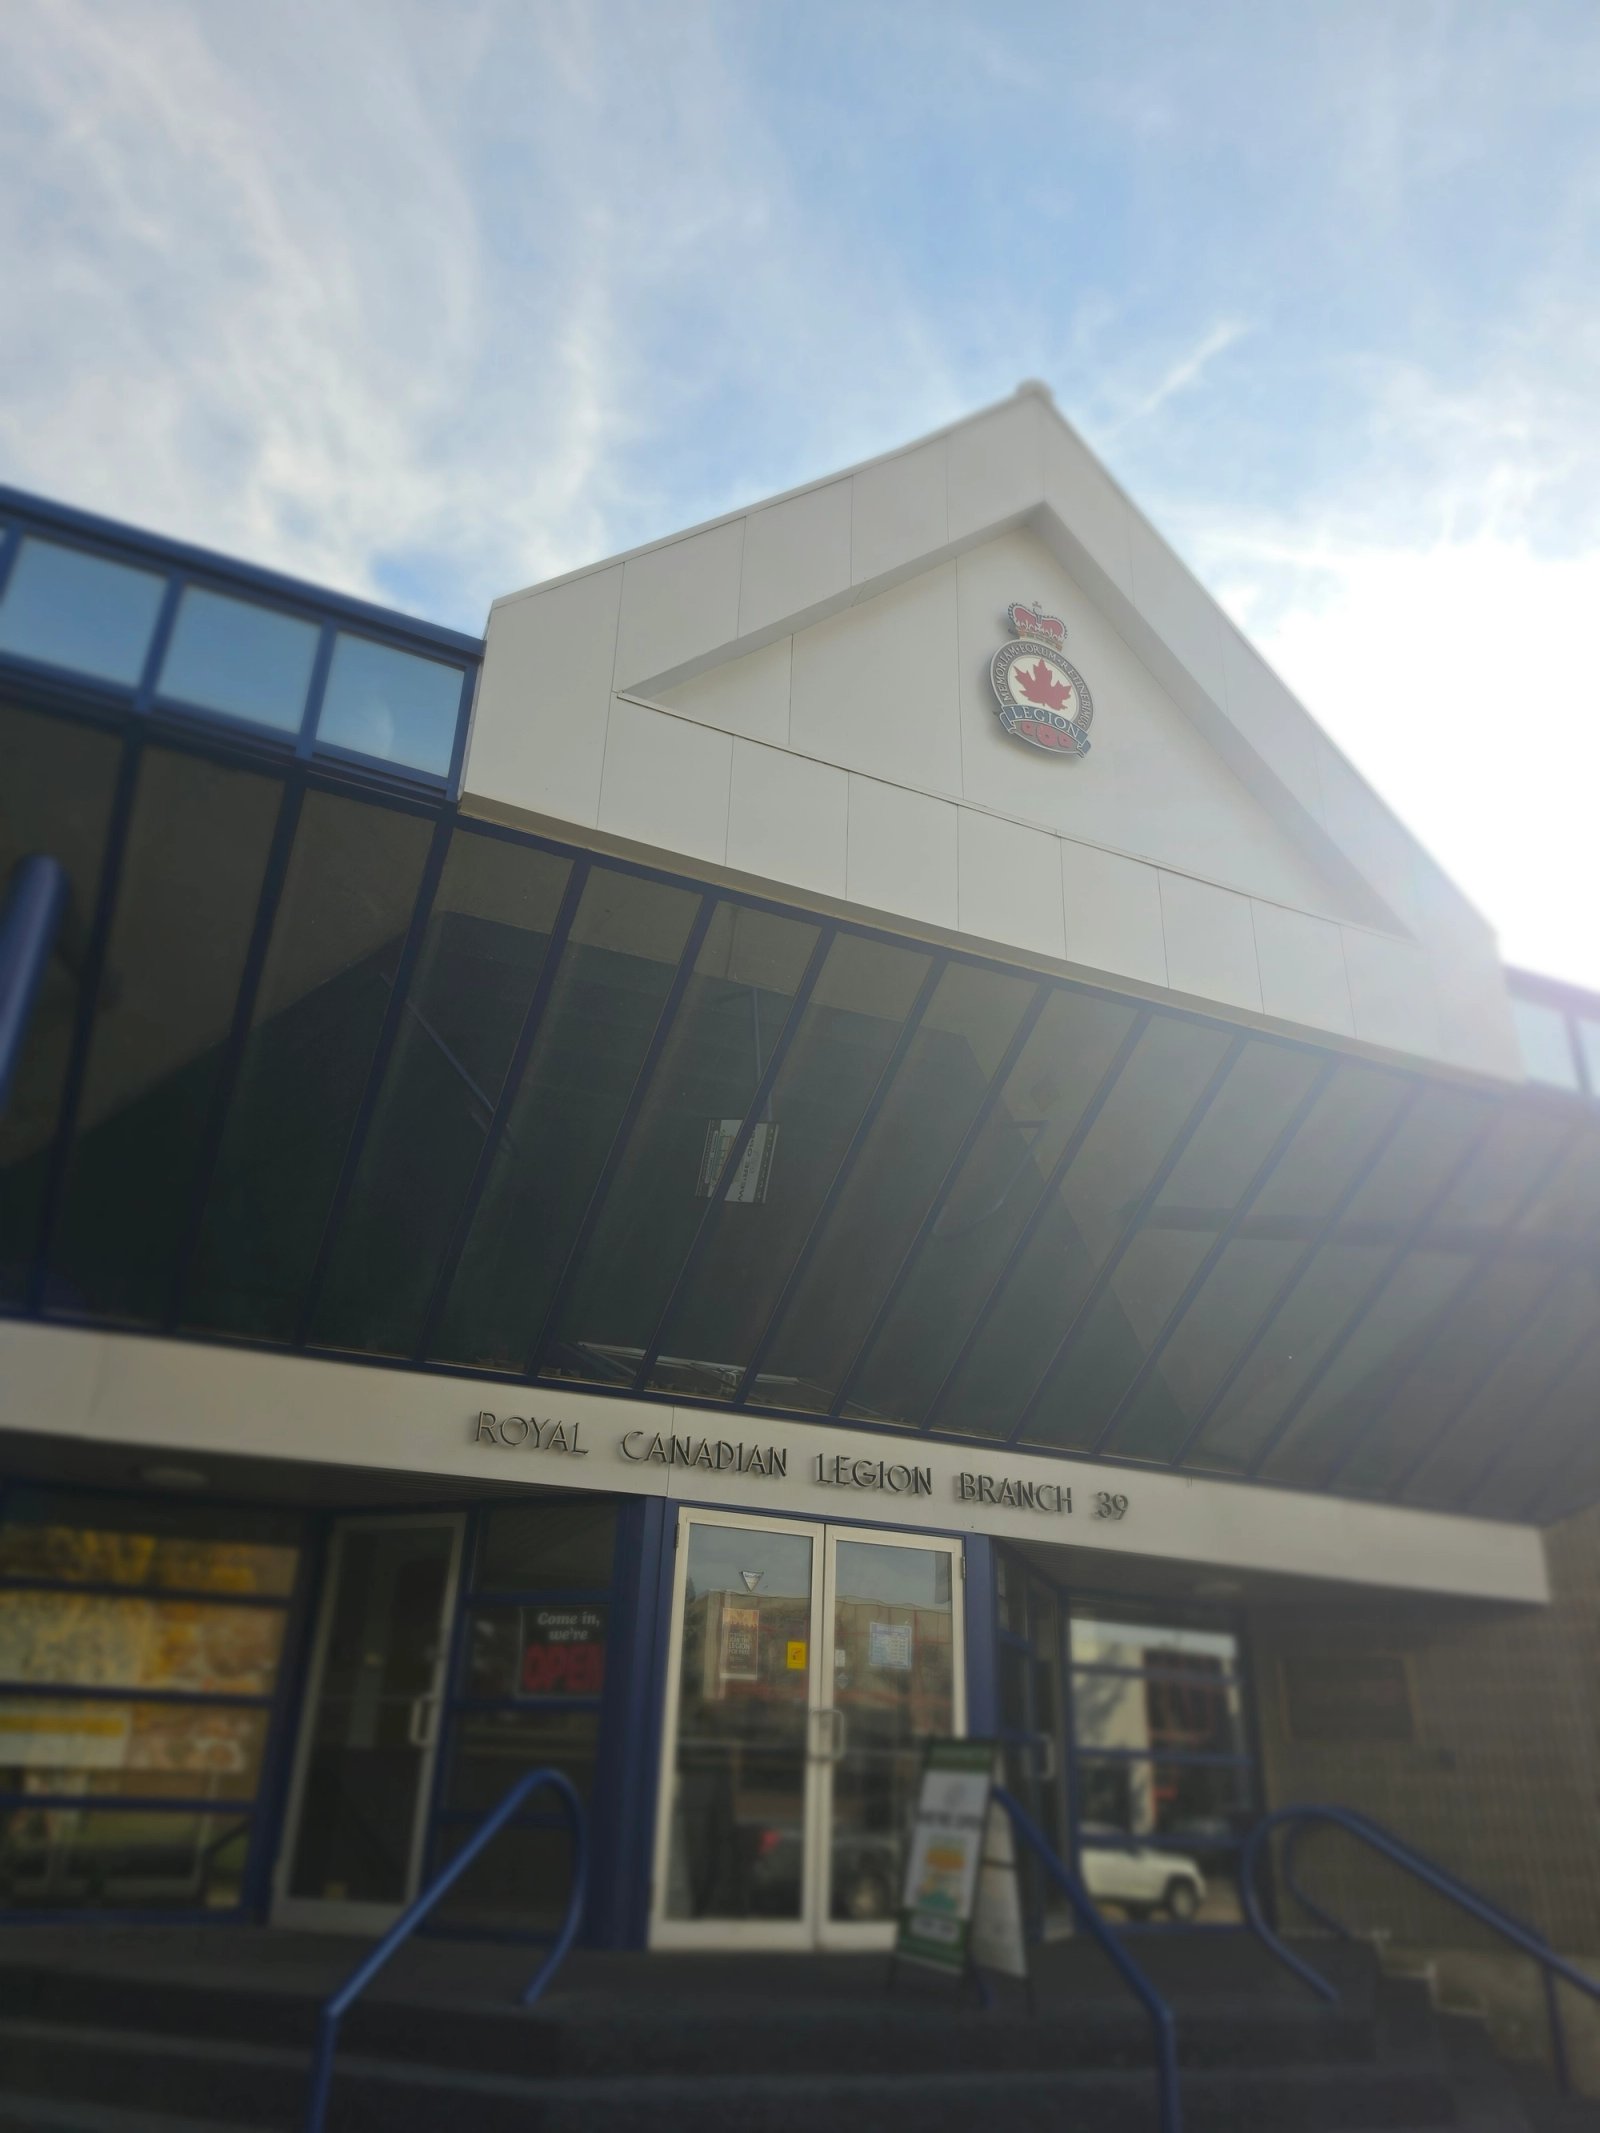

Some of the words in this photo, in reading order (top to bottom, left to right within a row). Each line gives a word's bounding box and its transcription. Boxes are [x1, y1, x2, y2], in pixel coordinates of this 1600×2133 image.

[995, 646, 1018, 702] MEMORIAM
[1020, 643, 1056, 660] EORUM
[1011, 706, 1080, 738] LEGION
[474, 1410, 589, 1456] ROYAL
[620, 1431, 788, 1477] CANADIAN
[815, 1452, 933, 1495] LEGION
[958, 1471, 1073, 1514] BRANCH
[1095, 1491, 1129, 1521] 39
[537, 1611, 578, 1626] Come
[549, 1627, 589, 1641] we're
